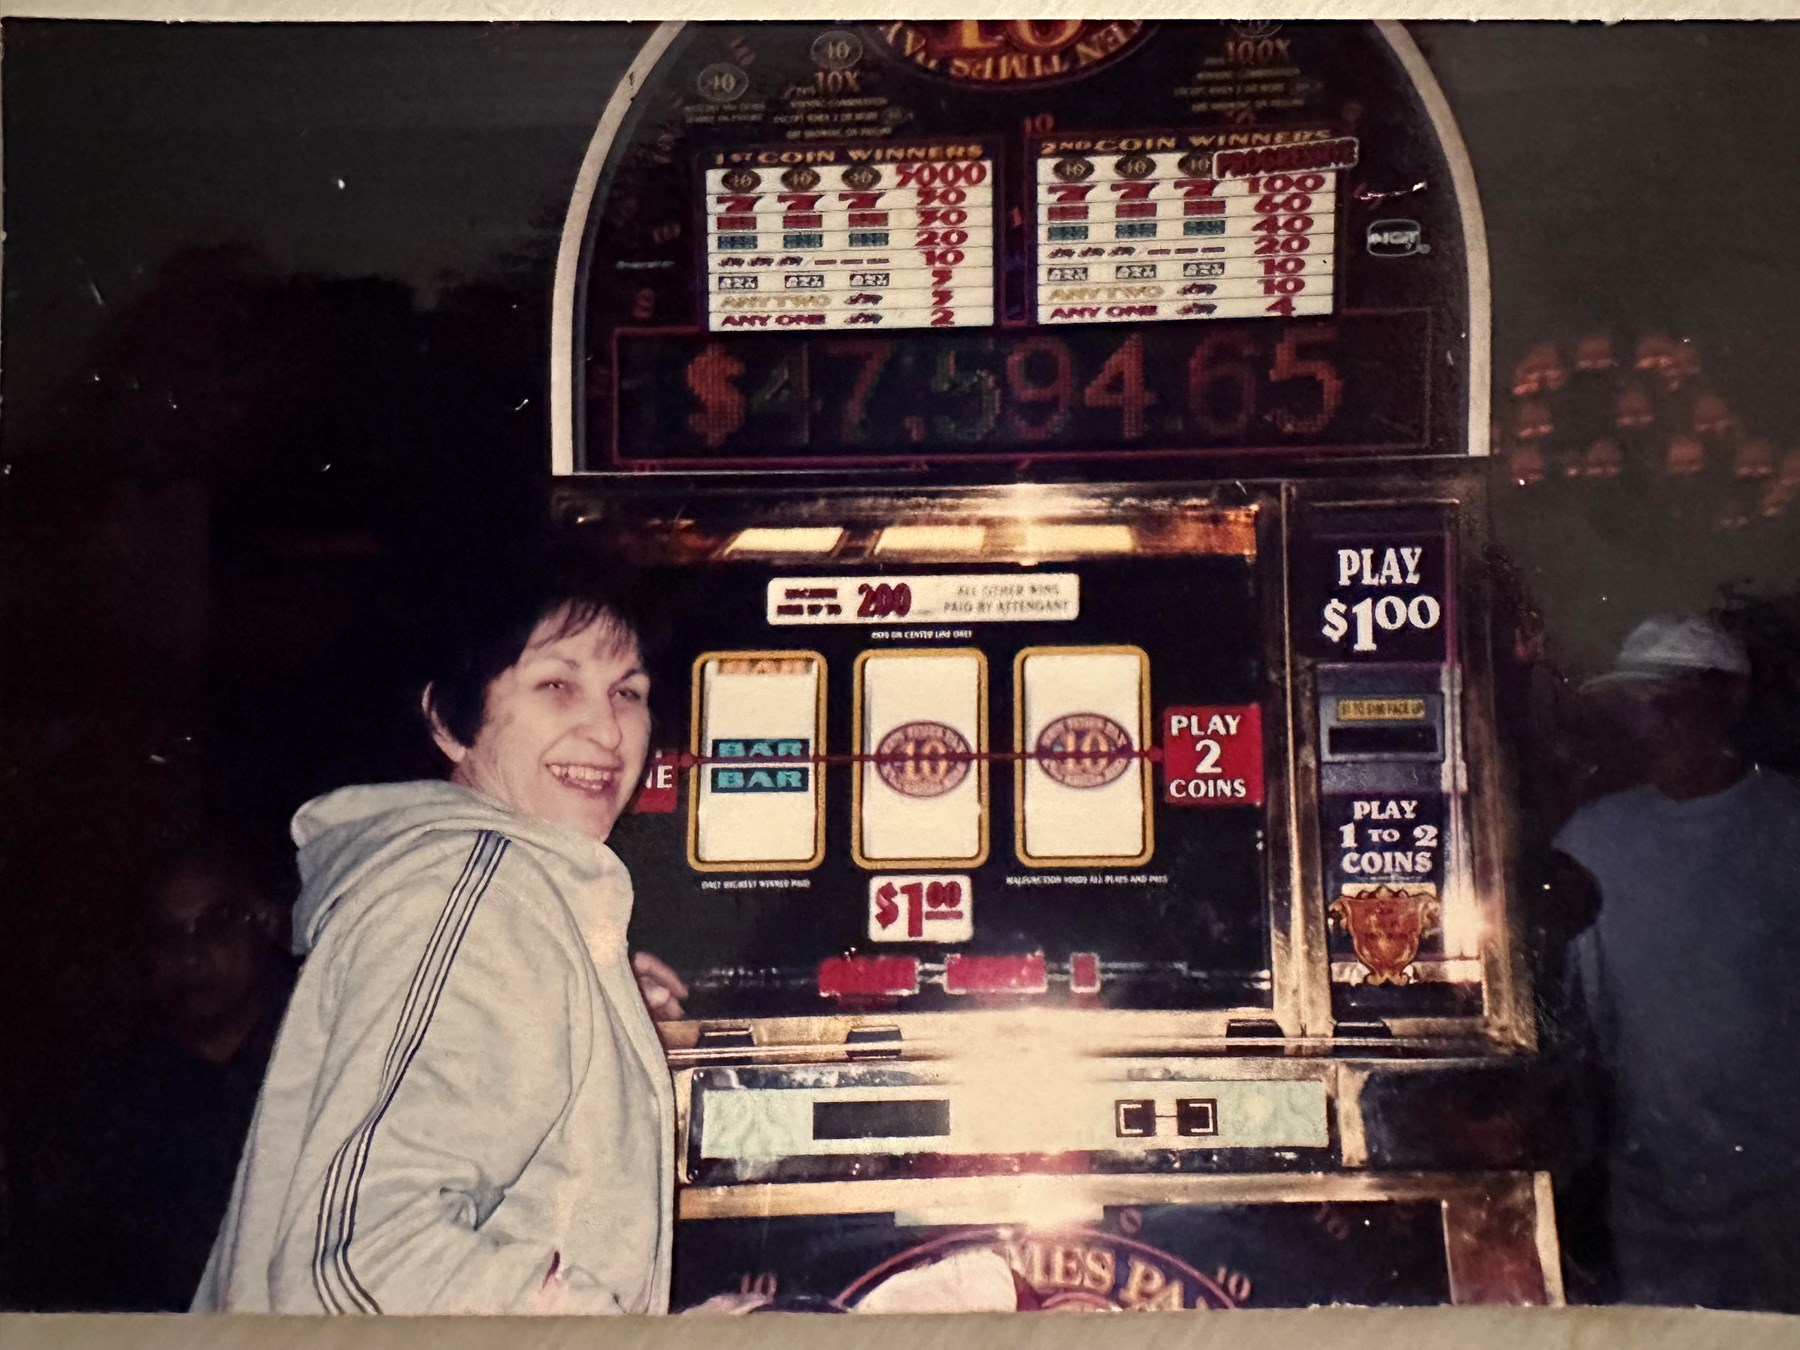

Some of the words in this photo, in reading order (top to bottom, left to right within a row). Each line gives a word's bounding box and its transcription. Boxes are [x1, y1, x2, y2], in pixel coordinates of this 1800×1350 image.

[1096, 136, 1177, 152] COIN
[1189, 130, 1333, 148] WINNERS
[757, 149, 836, 164] COIN
[848, 144, 984, 161] WINNERS
[1248, 173, 1326, 194] 100
[1251, 215, 1314, 234] 40
[915, 229, 969, 247] 20
[1253, 235, 1310, 255] 20
[922, 250, 965, 266] 10
[1257, 257, 1306, 275] 10
[1257, 276, 1306, 295] 10
[1050, 306, 1102, 319] ANY
[1265, 295, 1296, 317] 4
[721, 314, 773, 327] ANY
[931, 308, 955, 326] 2
[1338, 548, 1423, 586] PLAY
[857, 582, 912, 618] 200
[1170, 713, 1242, 737] PLAY
[718, 741, 803, 758] BAR
[1194, 740, 1222, 774] 2
[717, 771, 803, 788] BAR
[1168, 777, 1247, 799] COINS
[1353, 800, 1418, 820] PLAY
[1340, 824, 1357, 849] 1
[1368, 828, 1400, 843] TO
[1413, 824, 1438, 849] 2
[1342, 850, 1433, 874] COINS
